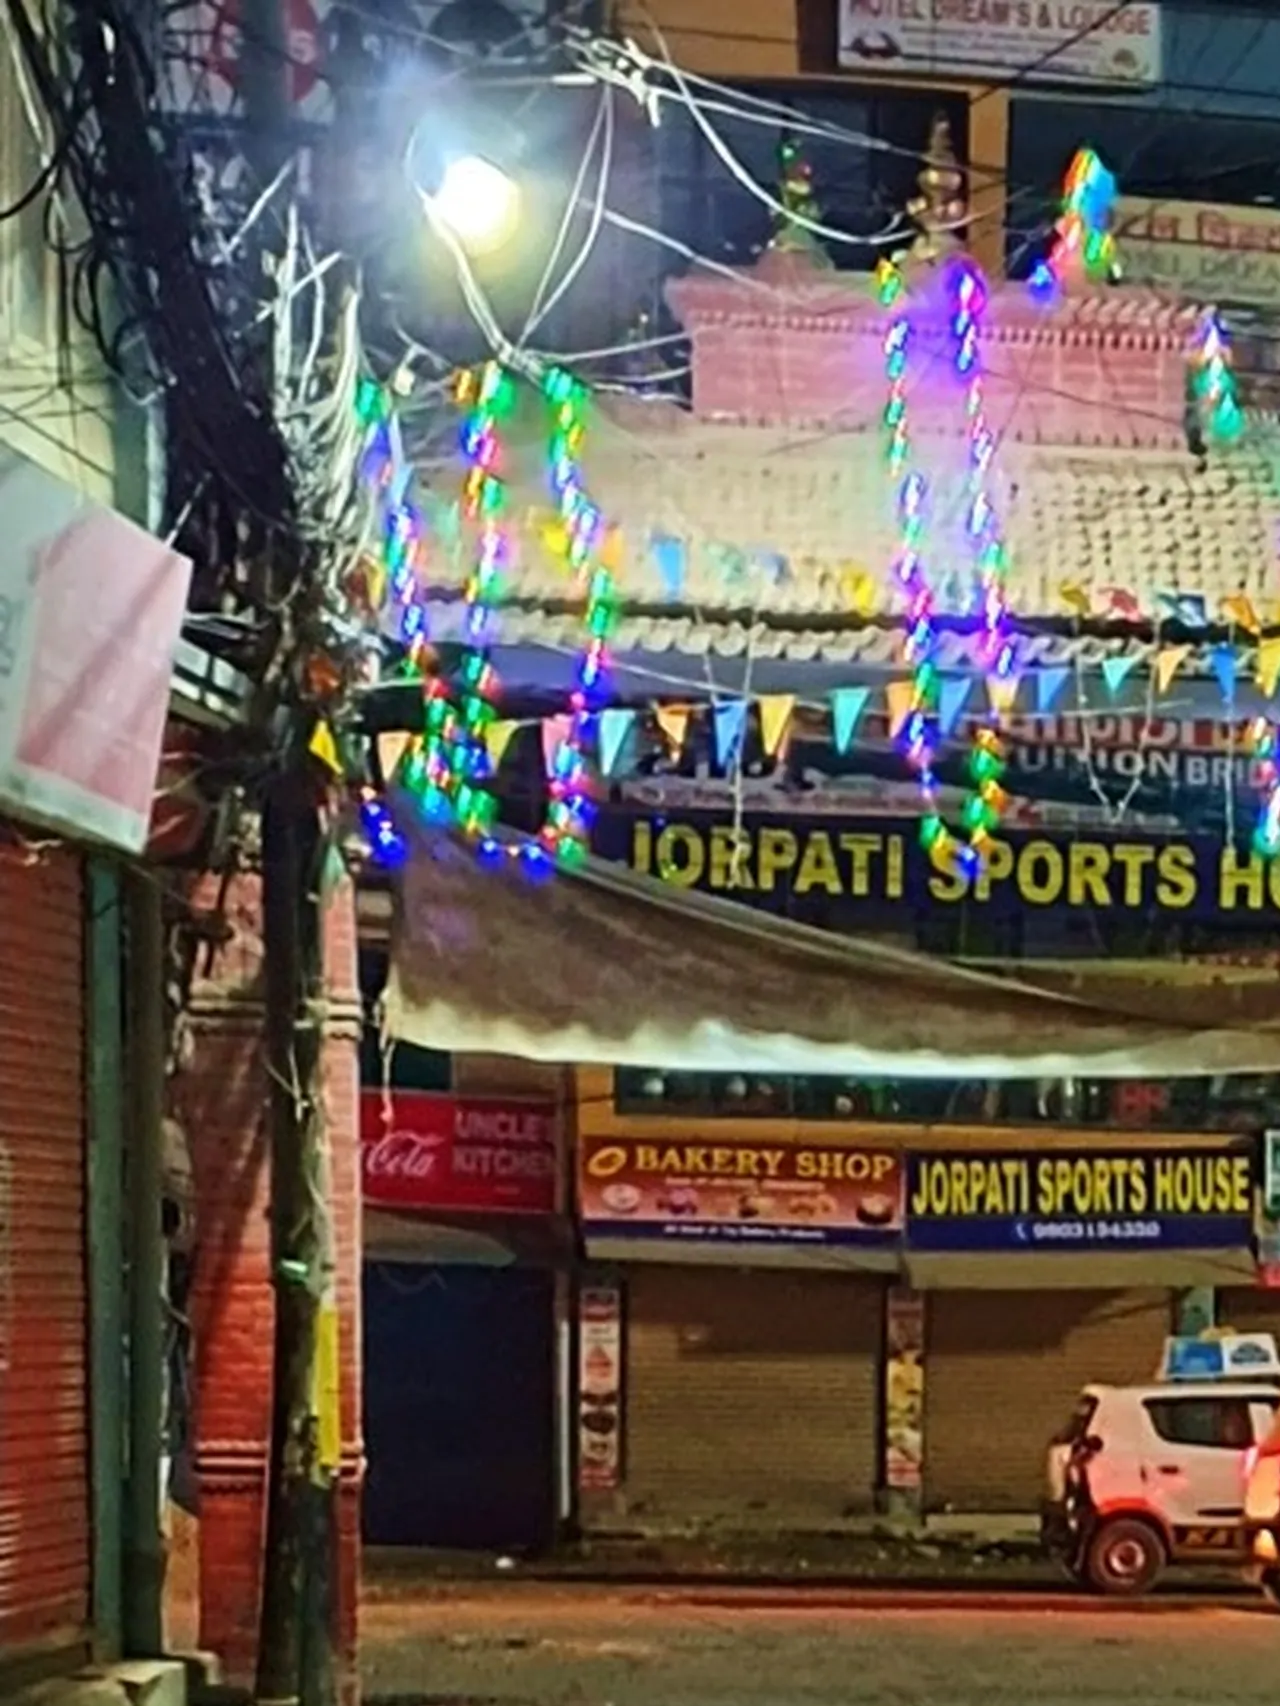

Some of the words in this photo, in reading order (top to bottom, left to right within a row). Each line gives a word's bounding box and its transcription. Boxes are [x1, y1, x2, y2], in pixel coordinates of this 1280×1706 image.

[928, 834, 1198, 908] SPORTS
[634, 1146, 785, 1175] BAKERY
[796, 1151, 895, 1181] SHOP
[912, 1159, 1030, 1215] JORPATI
[1036, 1157, 1147, 1213] SPORTS
[1154, 1156, 1250, 1212] HOUSE
